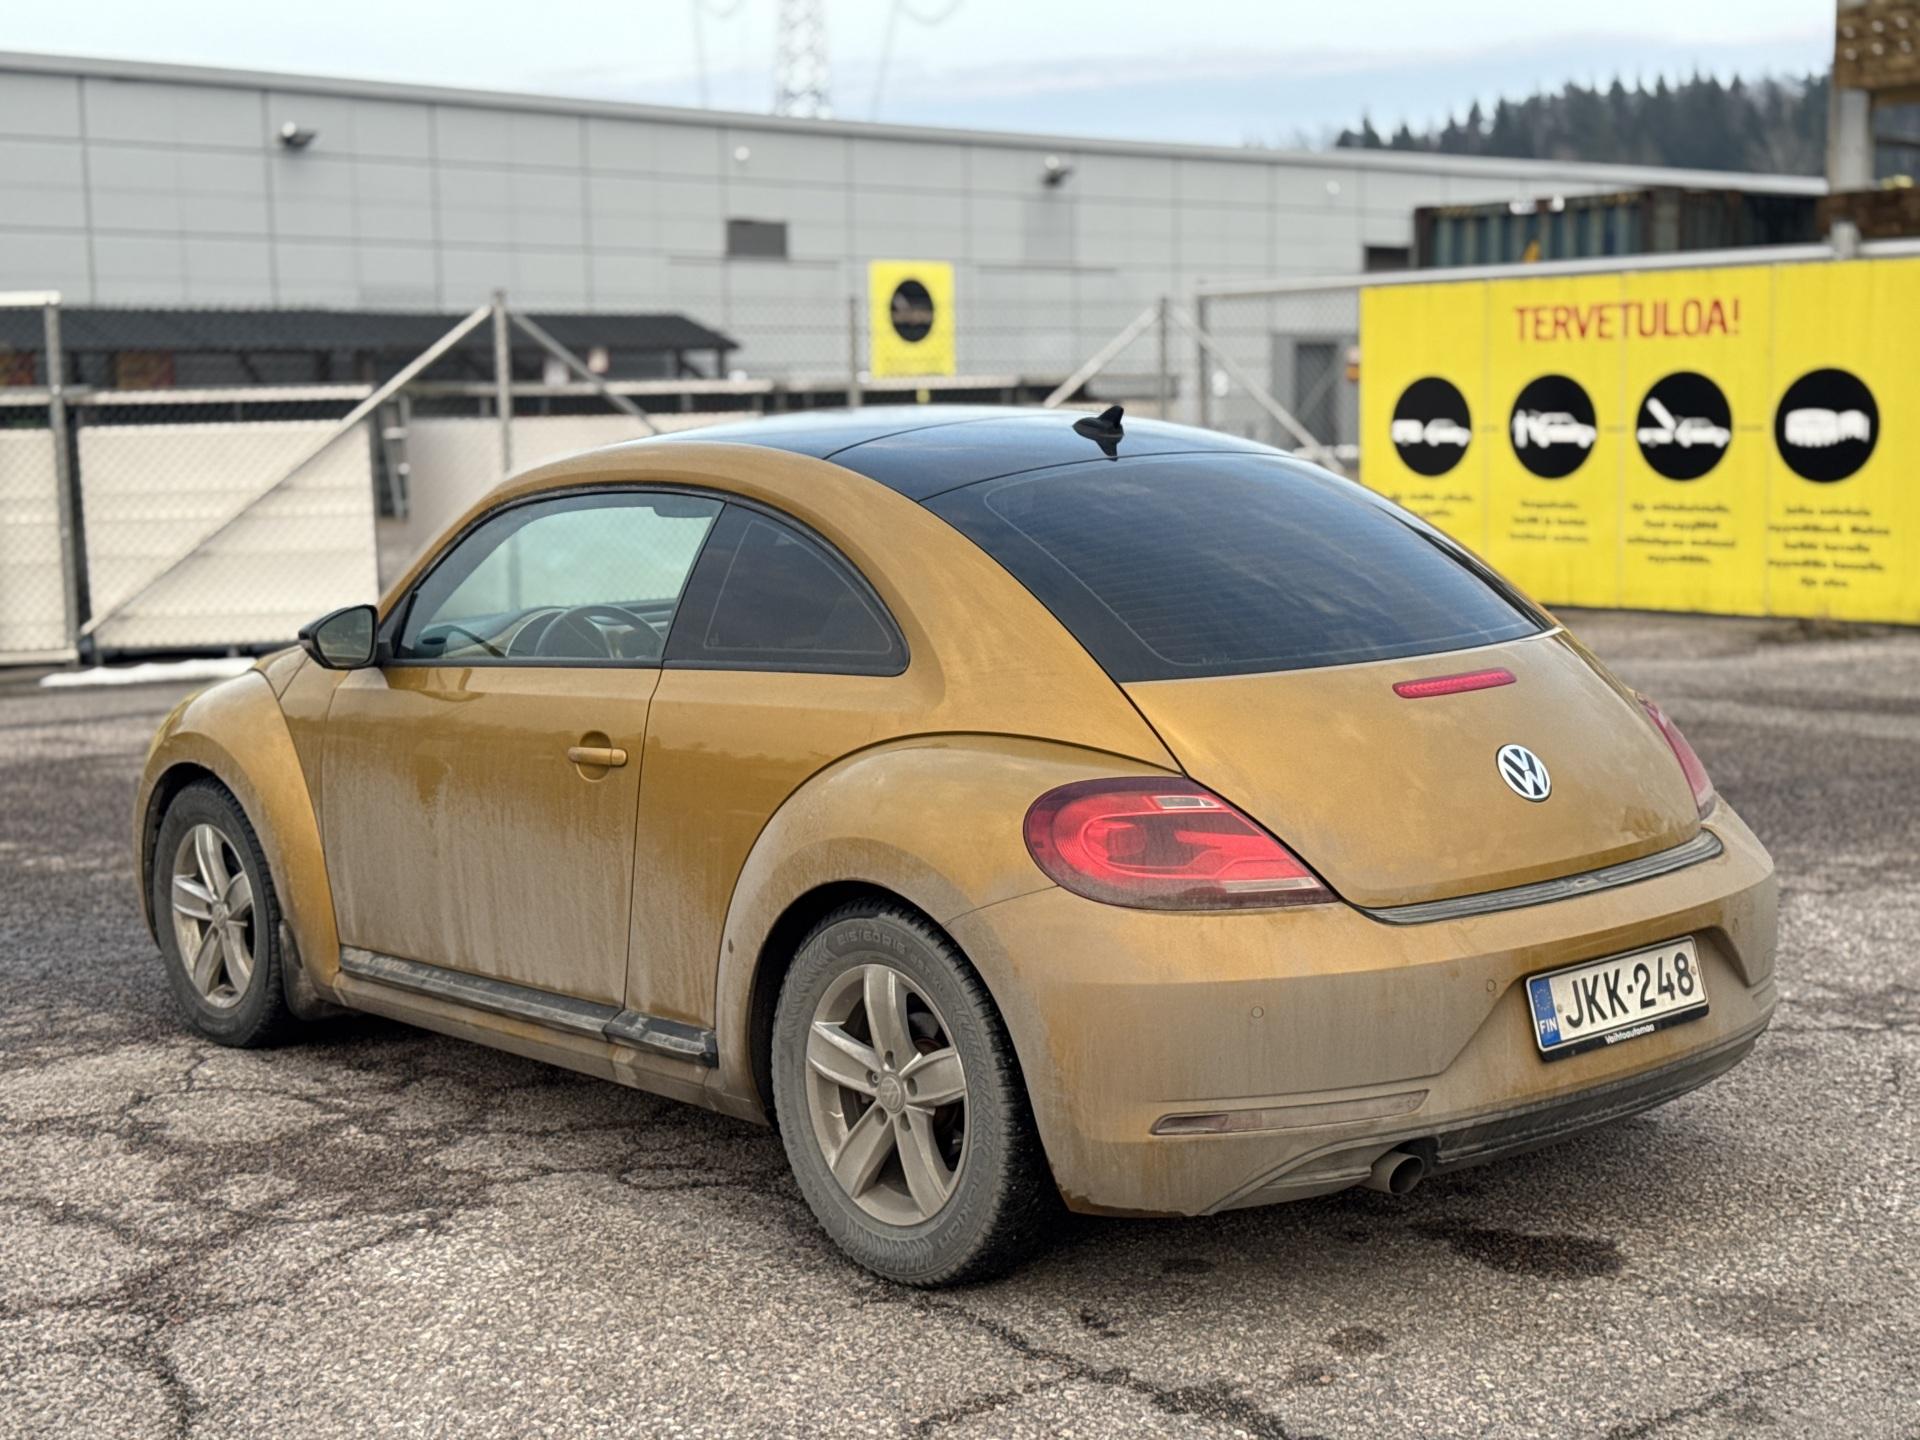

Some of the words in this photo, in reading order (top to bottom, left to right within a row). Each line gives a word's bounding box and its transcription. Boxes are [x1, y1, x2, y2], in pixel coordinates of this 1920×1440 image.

[1515, 299, 1739, 342] TERVETULOA!
[1565, 952, 1694, 1029] JKK-248
[1538, 1017, 1558, 1034] FIN
